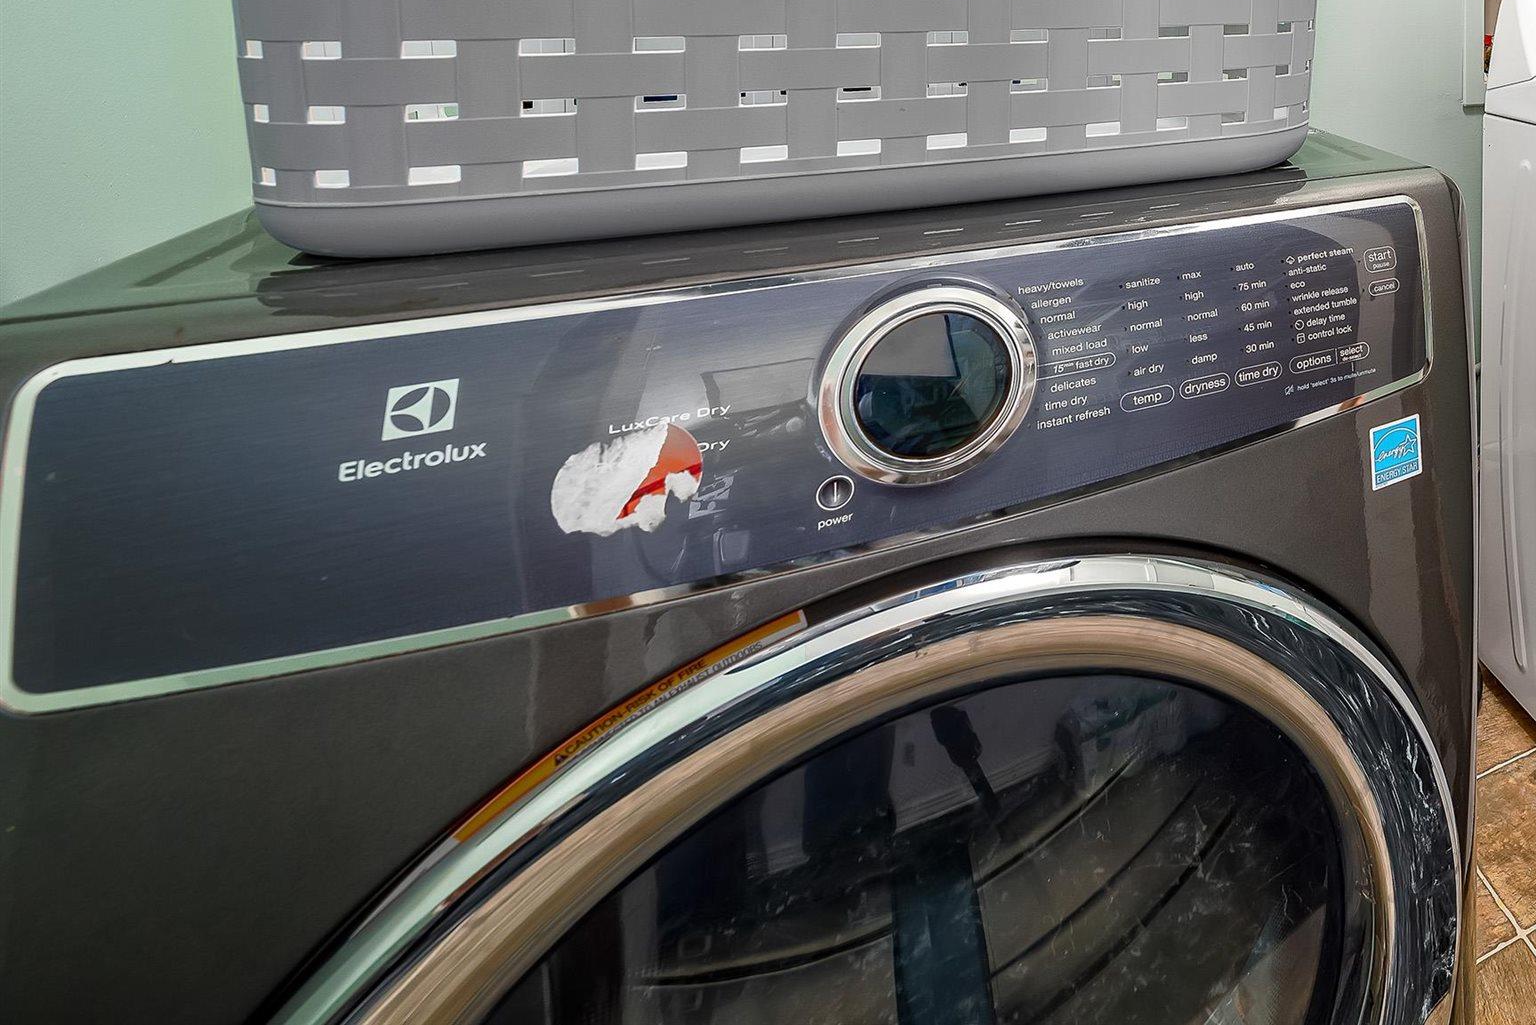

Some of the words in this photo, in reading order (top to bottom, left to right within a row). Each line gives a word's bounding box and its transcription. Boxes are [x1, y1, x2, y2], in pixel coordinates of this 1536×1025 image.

[1297, 250, 1328, 263] perfect
[1329, 247, 1354, 257] steam
[1368, 250, 1391, 263] start
[1235, 262, 1255, 272] auto
[1288, 263, 1327, 277] anti-static
[1181, 271, 1202, 280] max
[1018, 278, 1084, 295] heavy/towels
[1125, 277, 1160, 289] sanitize
[1238, 282, 1250, 291] 75
[1251, 280, 1267, 290] min
[1290, 281, 1306, 290] eco
[1184, 290, 1204, 301] high
[1291, 291, 1320, 302] wrinkle
[1321, 286, 1349, 297] release
[1031, 296, 1072, 309] allergen
[1127, 300, 1148, 311] high
[1241, 302, 1253, 312] 60
[1254, 300, 1270, 309] min
[1293, 302, 1330, 316] extended
[1331, 297, 1357, 309] tumble
[1040, 311, 1076, 324] normal
[1187, 308, 1218, 321] normal
[1306, 317, 1327, 327] delay
[1328, 314, 1346, 323] time
[1047, 324, 1102, 340] activewear
[1130, 318, 1163, 332] normal
[1243, 322, 1255, 332] 45
[1256, 320, 1273, 330] min
[1189, 333, 1208, 343] less
[1307, 328, 1335, 341] control
[1336, 325, 1353, 335] lock
[1052, 343, 1083, 356] mixed
[1085, 338, 1108, 350] load
[1131, 344, 1149, 354] low
[1245, 343, 1257, 354] 30
[1258, 340, 1275, 351] min
[1339, 345, 1363, 357] select
[1075, 360, 1093, 370] fast
[1094, 356, 1110, 366] dry
[1191, 353, 1218, 365] damp
[1296, 354, 1332, 370] options
[1133, 367, 1146, 377] air
[1148, 364, 1165, 373] dry
[1238, 370, 1260, 382] time
[1262, 366, 1279, 377] dry
[1050, 377, 1097, 393] delicates
[1184, 378, 1226, 394] dryness
[1045, 400, 1068, 411] time
[1070, 395, 1088, 406] dry
[1133, 392, 1162, 405] temp
[608, 412, 690, 434] LuxCare
[697, 405, 731, 418] Dry
[1037, 416, 1073, 430] instant
[1075, 406, 1111, 421] refresh
[338, 442, 488, 482] Electrolux
[1377, 468, 1401, 484] ENERGY
[1402, 462, 1418, 474] STAR
[818, 513, 854, 531] power
[712, 642, 763, 673] OUTDOORS
[657, 678, 675, 692] OF
[678, 659, 706, 679] FIRE
